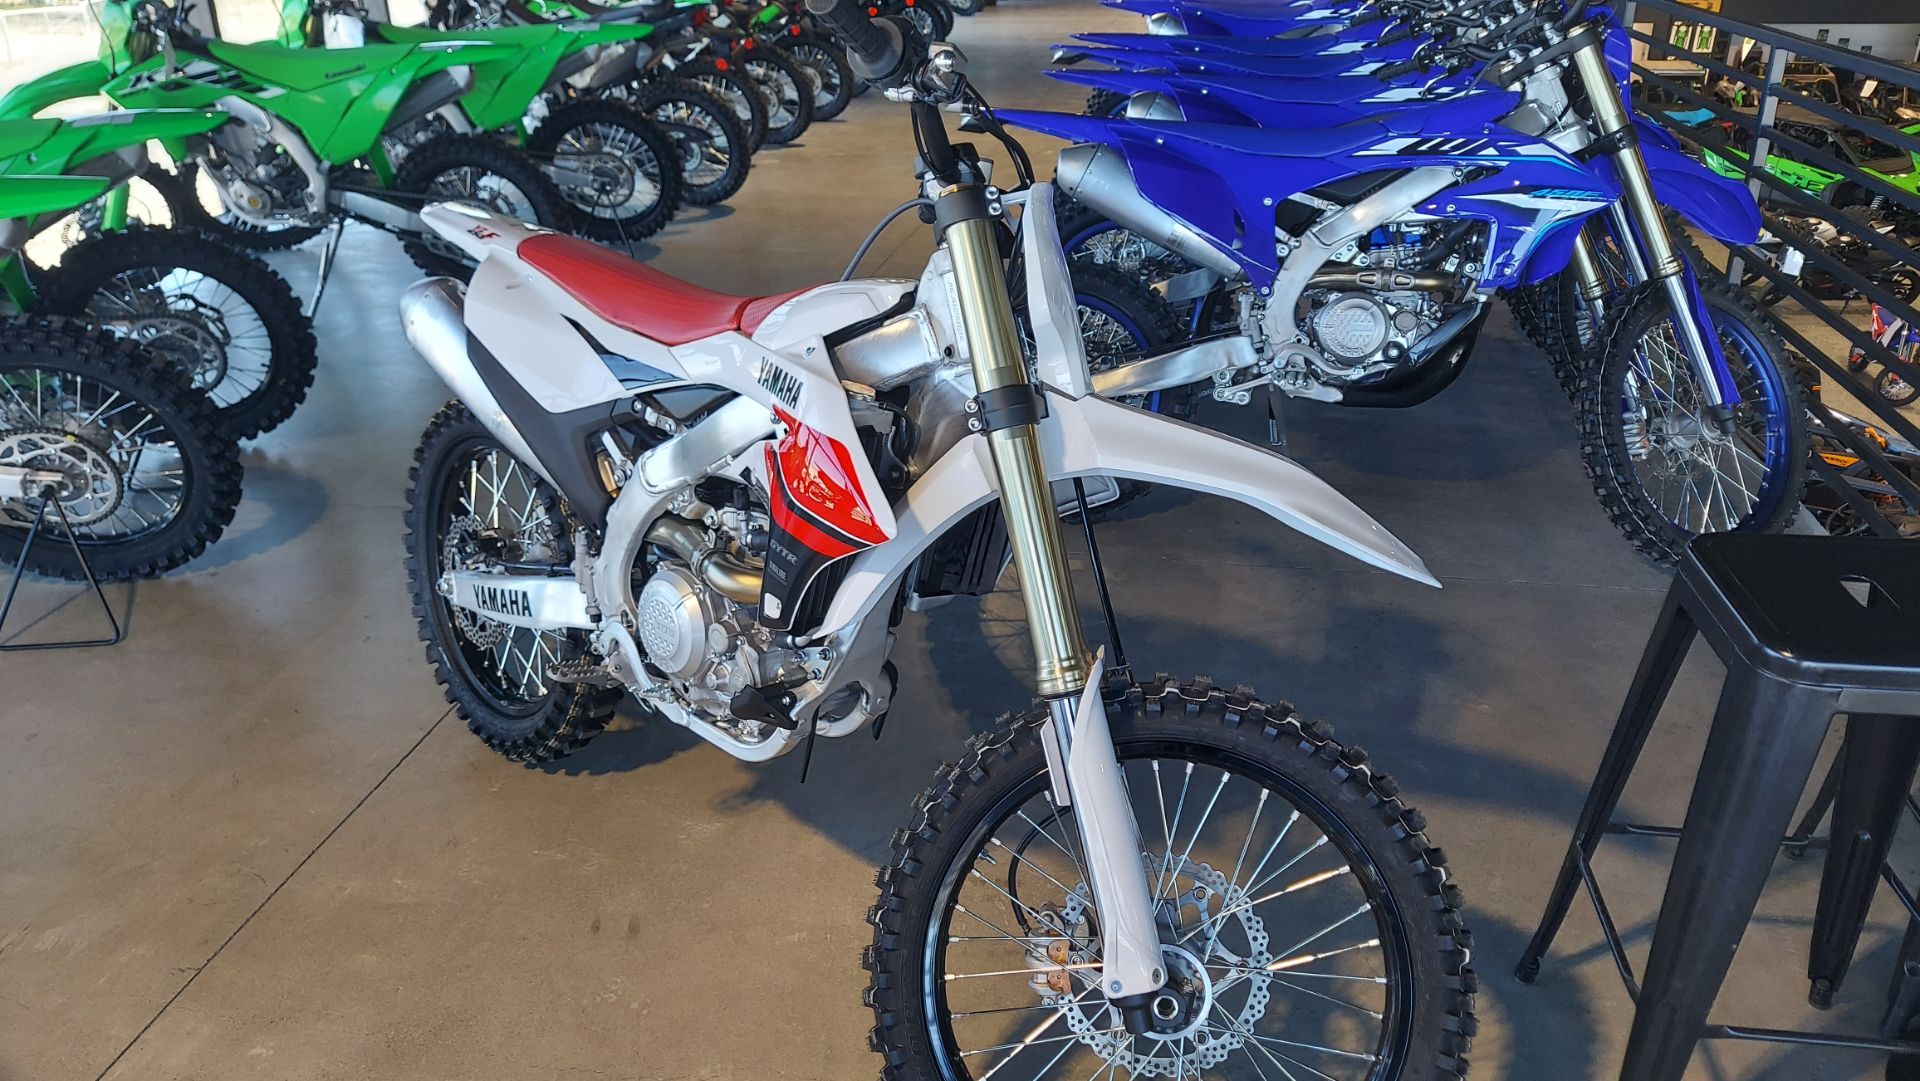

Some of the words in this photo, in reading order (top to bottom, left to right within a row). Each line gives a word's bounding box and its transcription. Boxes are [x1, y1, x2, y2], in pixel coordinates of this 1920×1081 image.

[757, 356, 804, 410] YAMAHA
[769, 538, 798, 566] GYTR
[472, 583, 532, 617] YAMAHA
